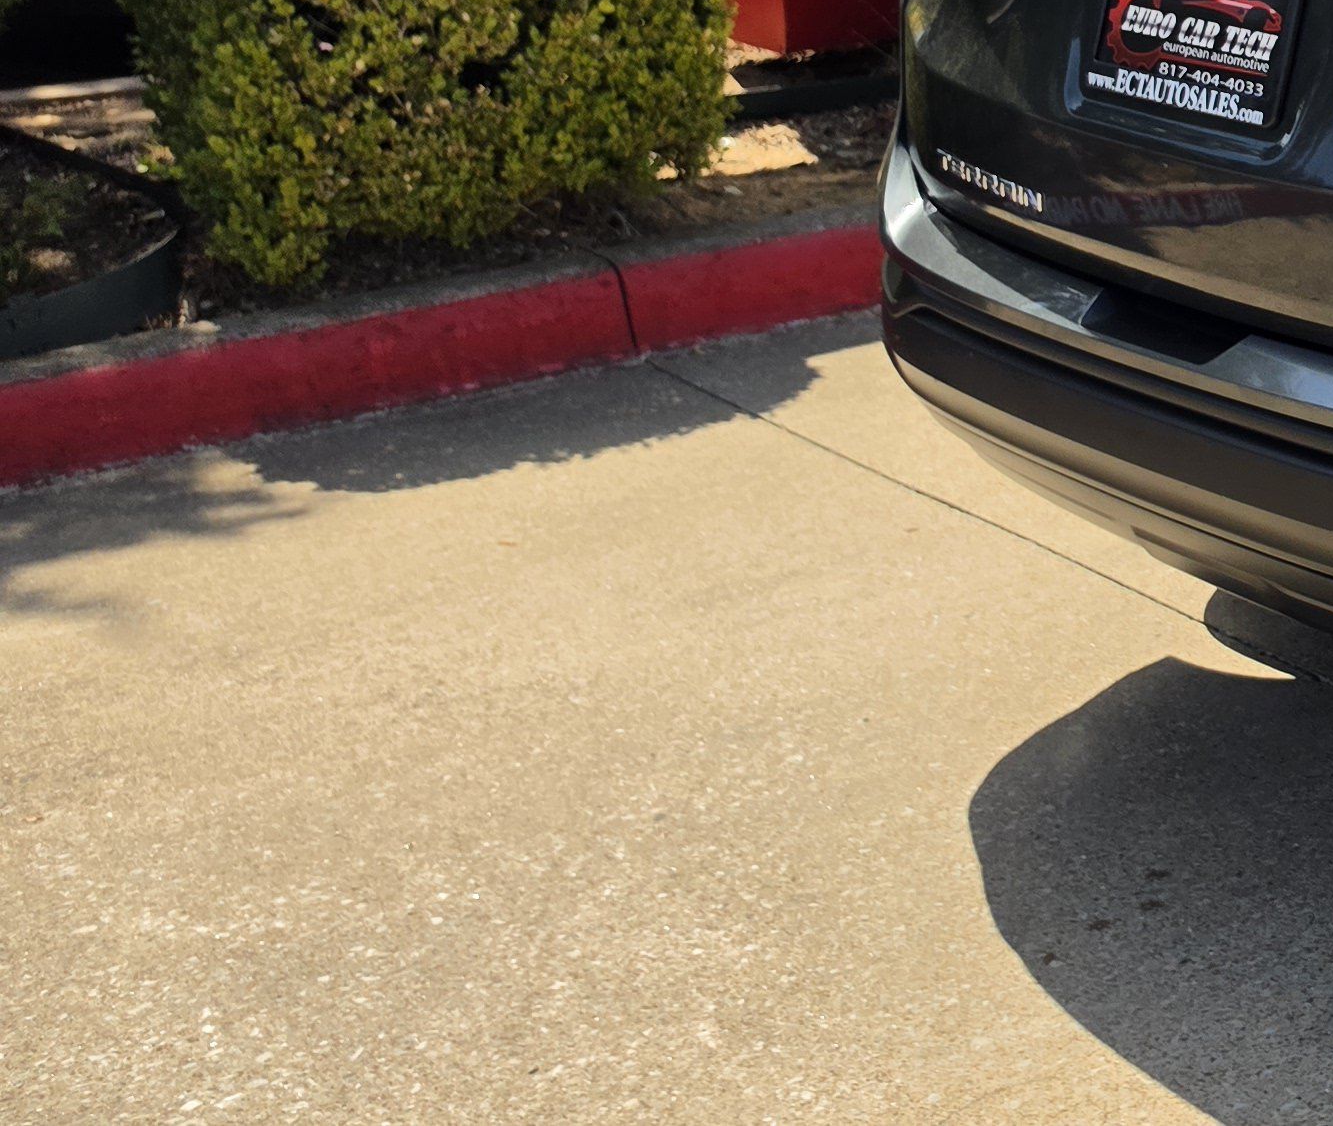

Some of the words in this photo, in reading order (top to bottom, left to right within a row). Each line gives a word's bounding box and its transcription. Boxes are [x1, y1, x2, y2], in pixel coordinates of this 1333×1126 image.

[1121, 4, 1177, 40] EURO
[1177, 15, 1221, 49] CAR
[1220, 25, 1279, 61] TECH
[1158, 61, 1265, 98] 817-404-4033
[1162, 41, 1210, 61] european
[1210, 52, 1271, 74] automotive
[1087, 68, 1264, 126] www.ECTAUTOSALES.com
